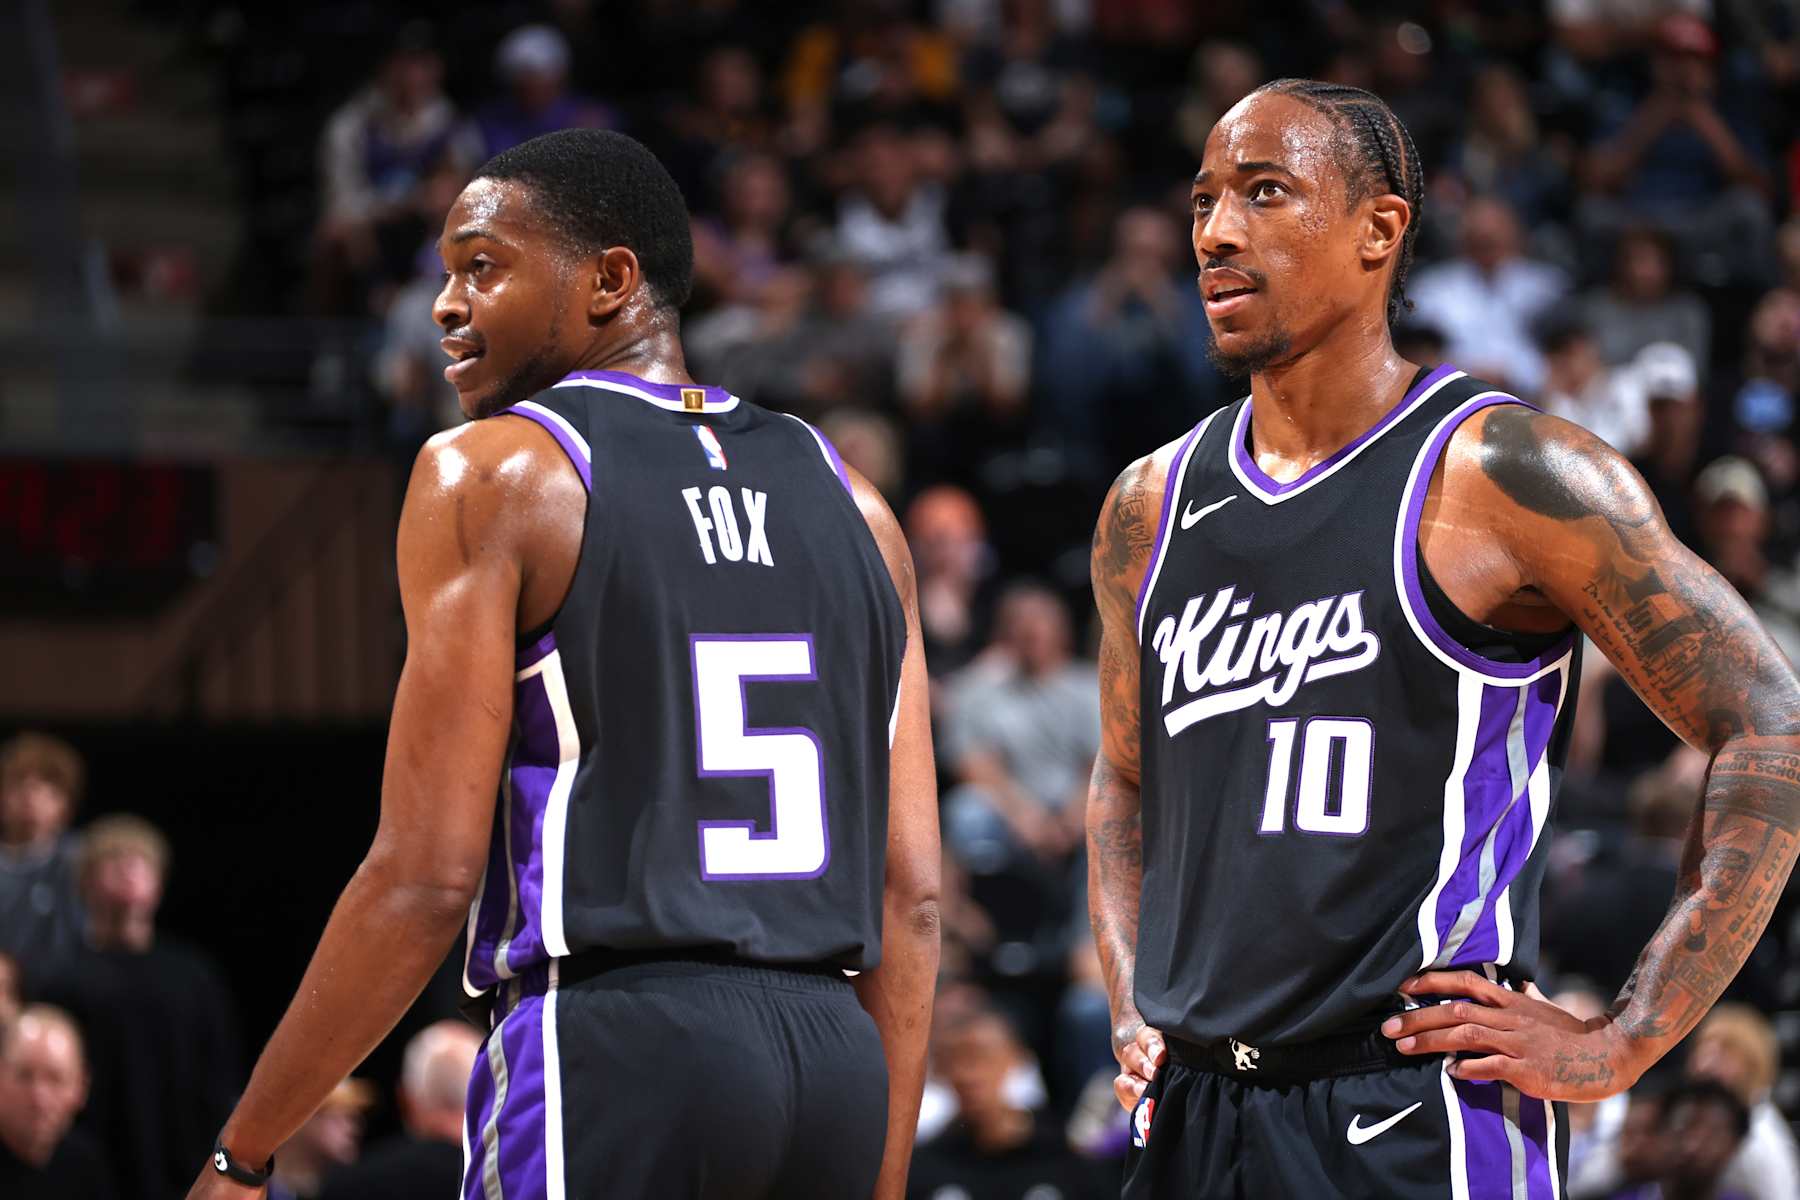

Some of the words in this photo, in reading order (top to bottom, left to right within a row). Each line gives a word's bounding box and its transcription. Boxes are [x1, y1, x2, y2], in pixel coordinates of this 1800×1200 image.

[682, 485, 775, 567] FOX
[1151, 584, 1381, 738] Kings
[690, 633, 831, 881] 5
[1257, 715, 1375, 838] 10
